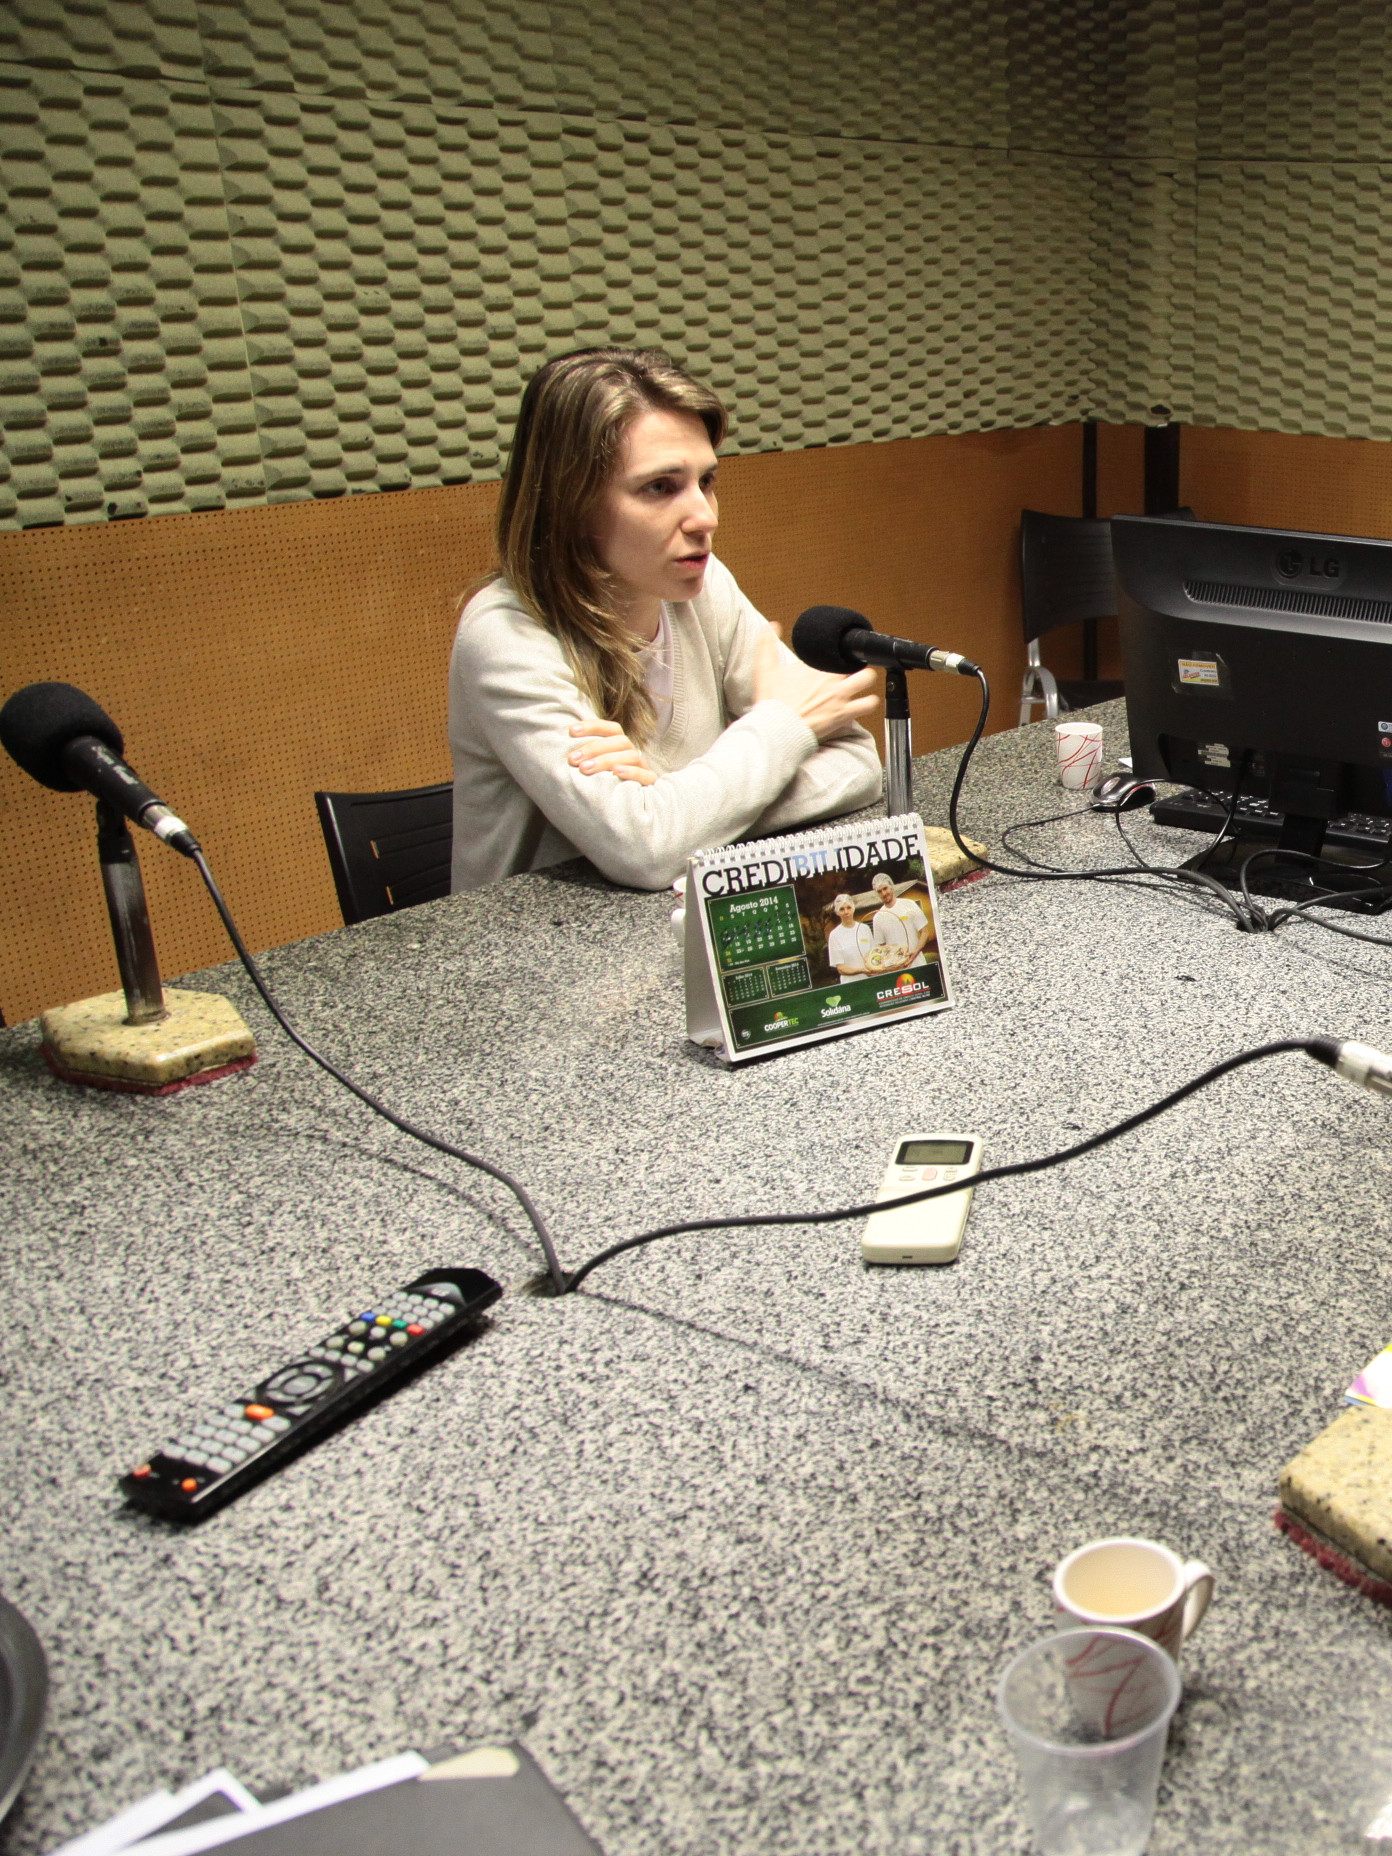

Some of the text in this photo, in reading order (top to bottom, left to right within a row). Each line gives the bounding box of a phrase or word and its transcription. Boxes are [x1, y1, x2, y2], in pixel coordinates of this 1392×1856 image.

[702, 834, 921, 896] CREDIBILIDADE
[730, 896, 779, 913] Agosto 2014
[876, 981, 929, 1000] CRESOL
[764, 1017, 800, 1032] COOPERTEC
